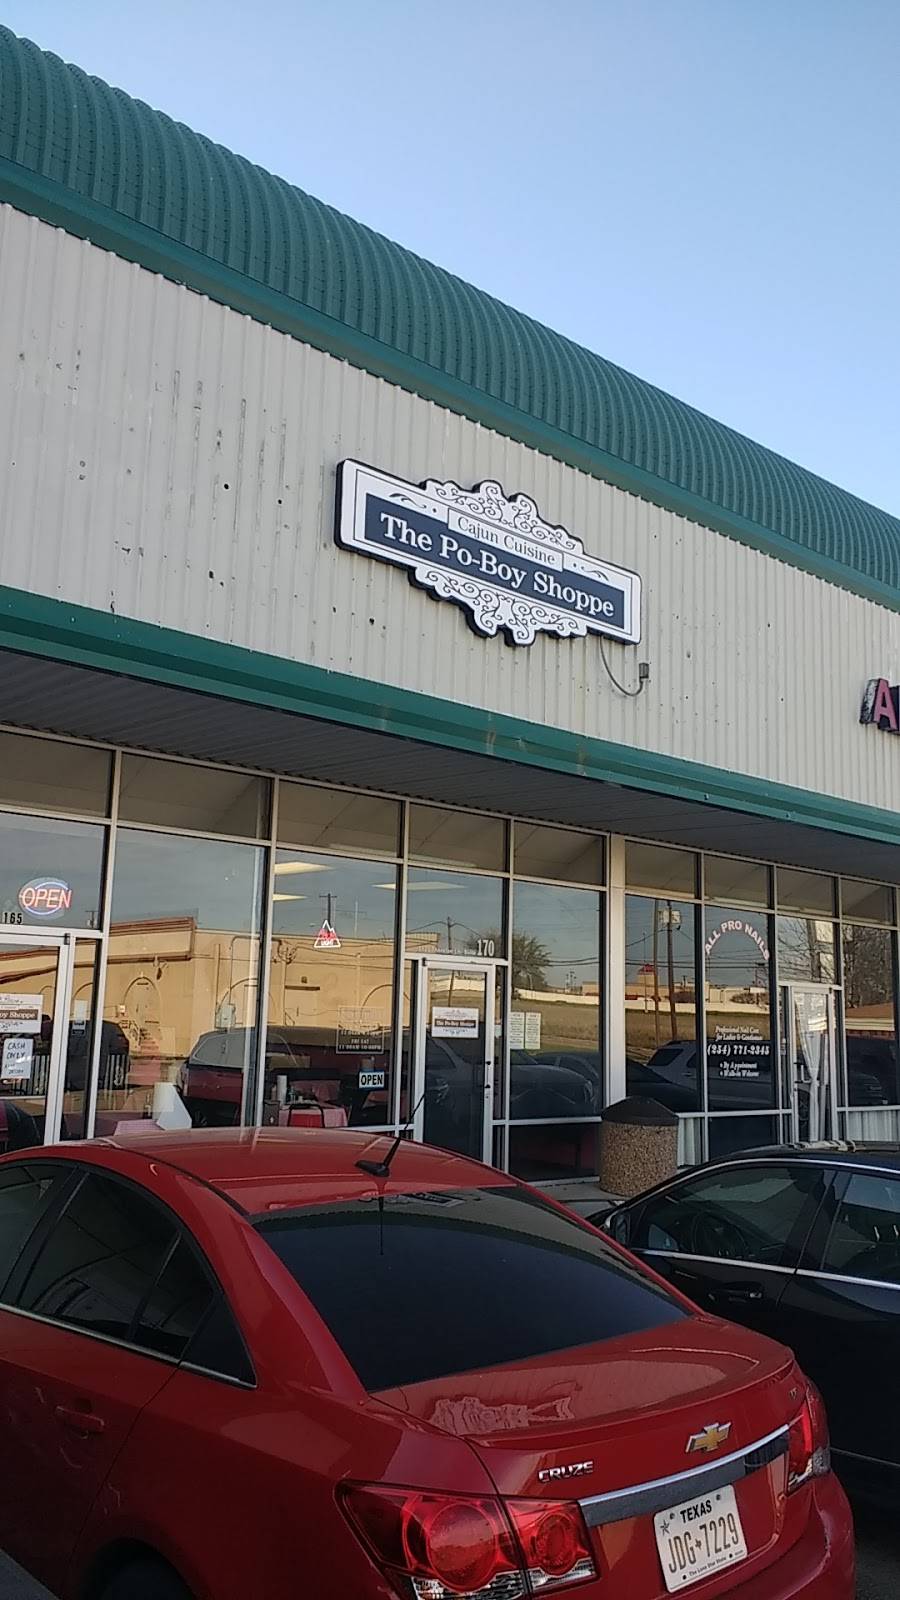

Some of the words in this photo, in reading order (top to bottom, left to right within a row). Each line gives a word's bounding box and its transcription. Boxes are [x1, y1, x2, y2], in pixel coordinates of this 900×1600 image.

[457, 515, 500, 545] Cajun
[503, 534, 556, 566] Cuisine
[380, 513, 433, 552] The
[439, 534, 526, 589] Po-Boy
[533, 572, 615, 618] Shoppe
[21, 887, 72, 909] OPEN
[3, 912, 23, 925] 165
[477, 939, 495, 957] 170
[704, 928, 721, 955] ALL
[721, 919, 743, 933] PRO
[744, 923, 770, 961] NAILS
[9, 1012, 36, 1020] Shoppe
[7, 1042, 26, 1050] CASH
[361, 1073, 384, 1086] OPEN
[537, 1460, 594, 1483] CRUZE
[679, 1499, 713, 1524] TEXAS
